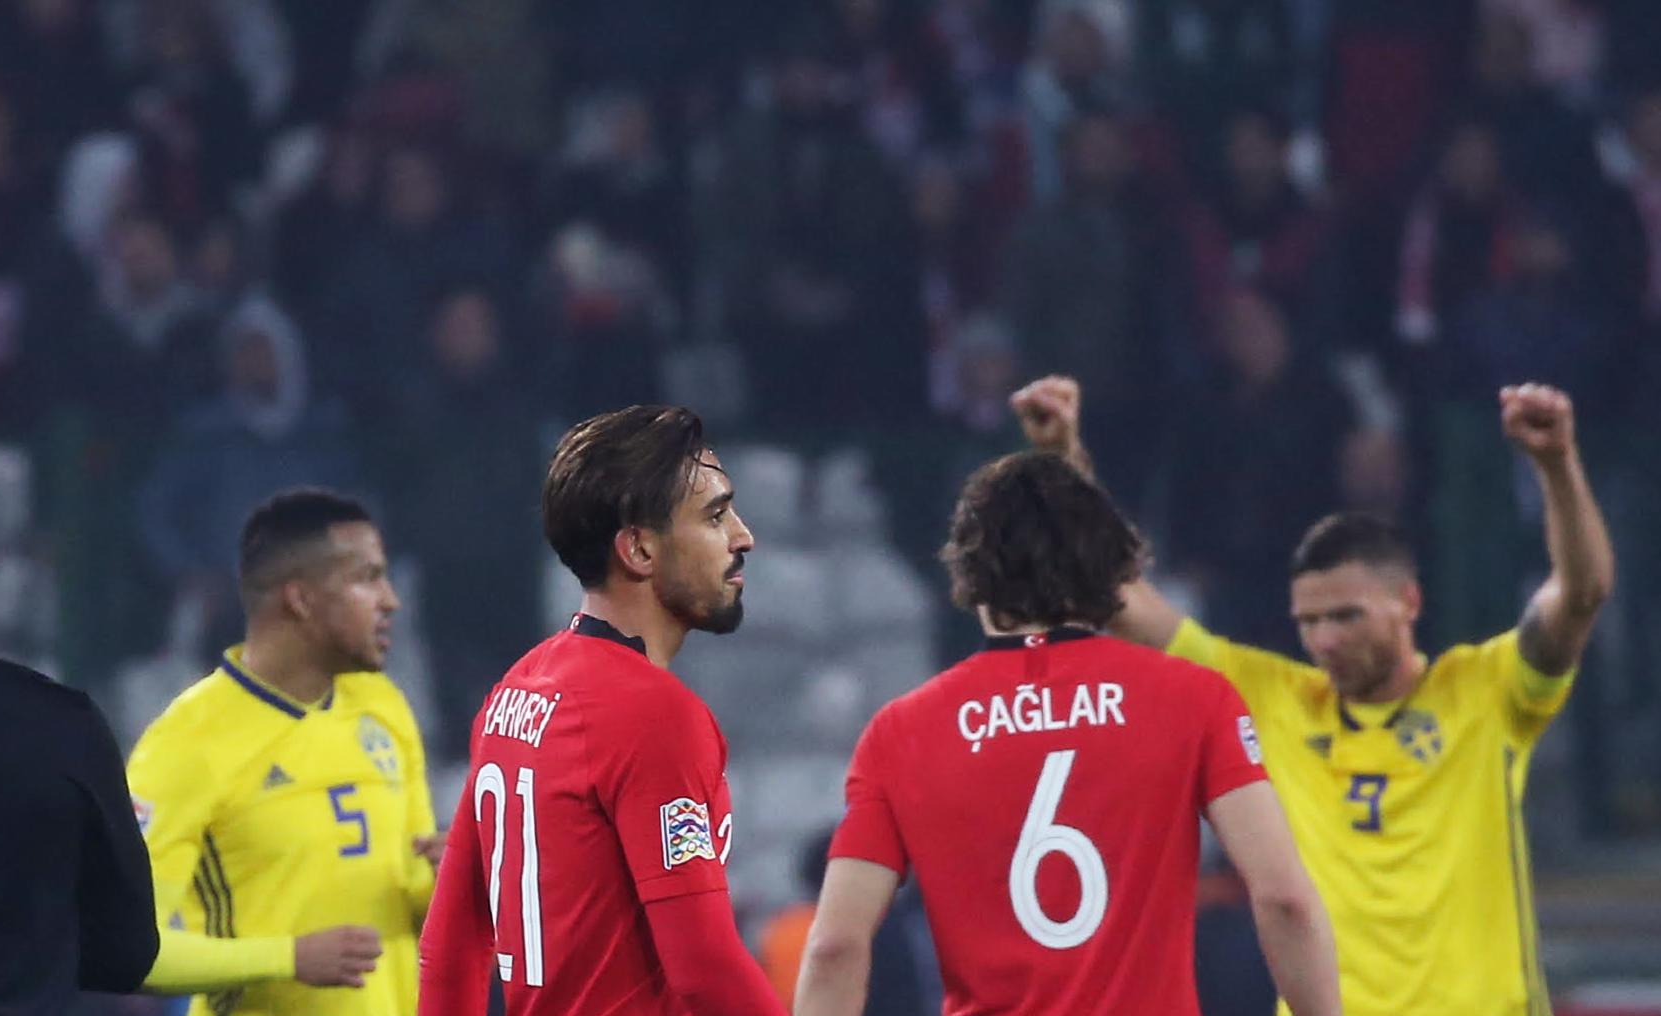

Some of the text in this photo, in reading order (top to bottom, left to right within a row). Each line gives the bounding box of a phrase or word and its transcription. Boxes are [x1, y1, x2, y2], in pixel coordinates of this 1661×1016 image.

[958, 682, 1126, 752] ÇAĞLAR
[327, 783, 370, 857] 5
[1347, 773, 1389, 832] 9
[474, 762, 543, 987] 21
[1009, 749, 1108, 949] 6
